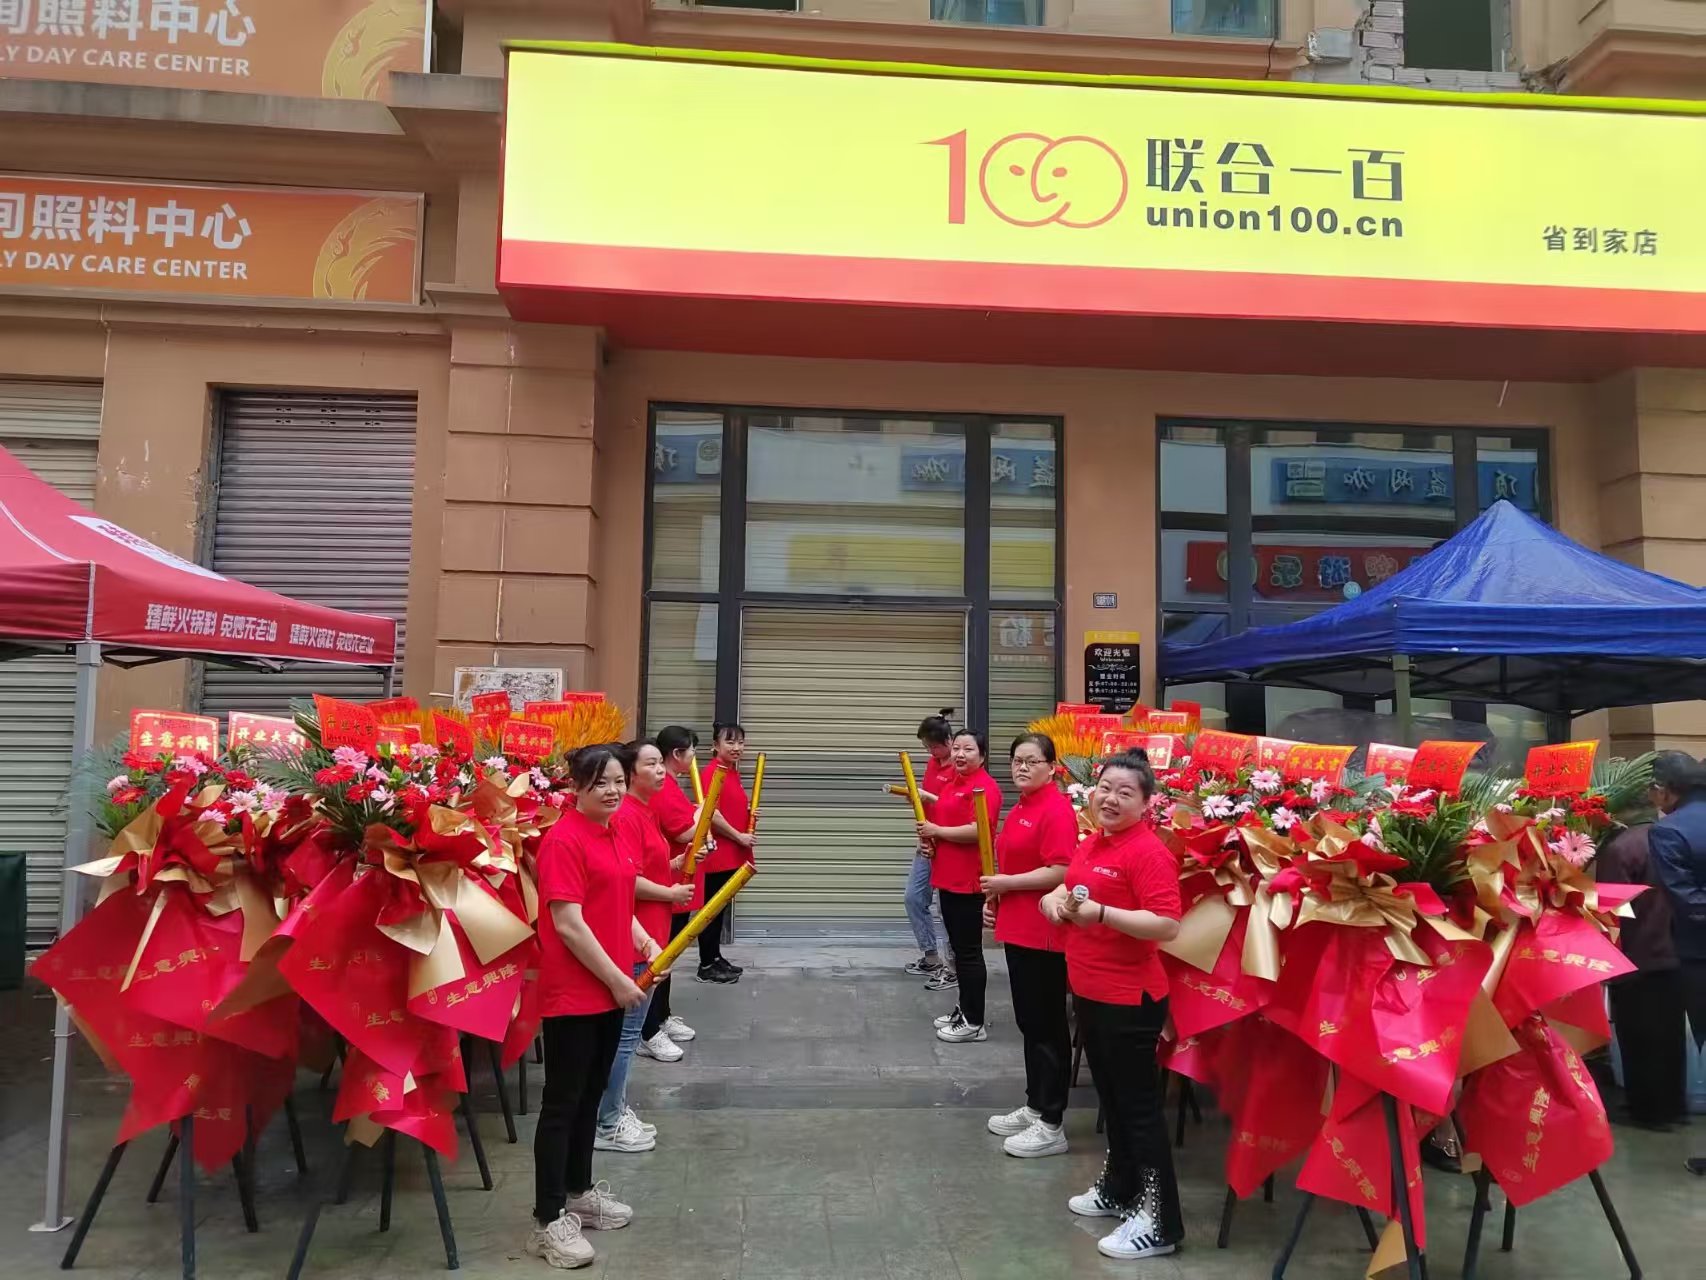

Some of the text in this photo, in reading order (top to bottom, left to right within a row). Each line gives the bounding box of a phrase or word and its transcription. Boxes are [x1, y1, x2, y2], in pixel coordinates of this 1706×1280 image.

[0, 46, 250, 76] Y DAY CARE CENTER
[1146, 138, 1405, 201] 联合一百
[1146, 201, 1403, 237] union100.cn
[1542, 225, 1658, 256] 省到家店
[0, 250, 248, 280] Y DAY CARE CENTER
